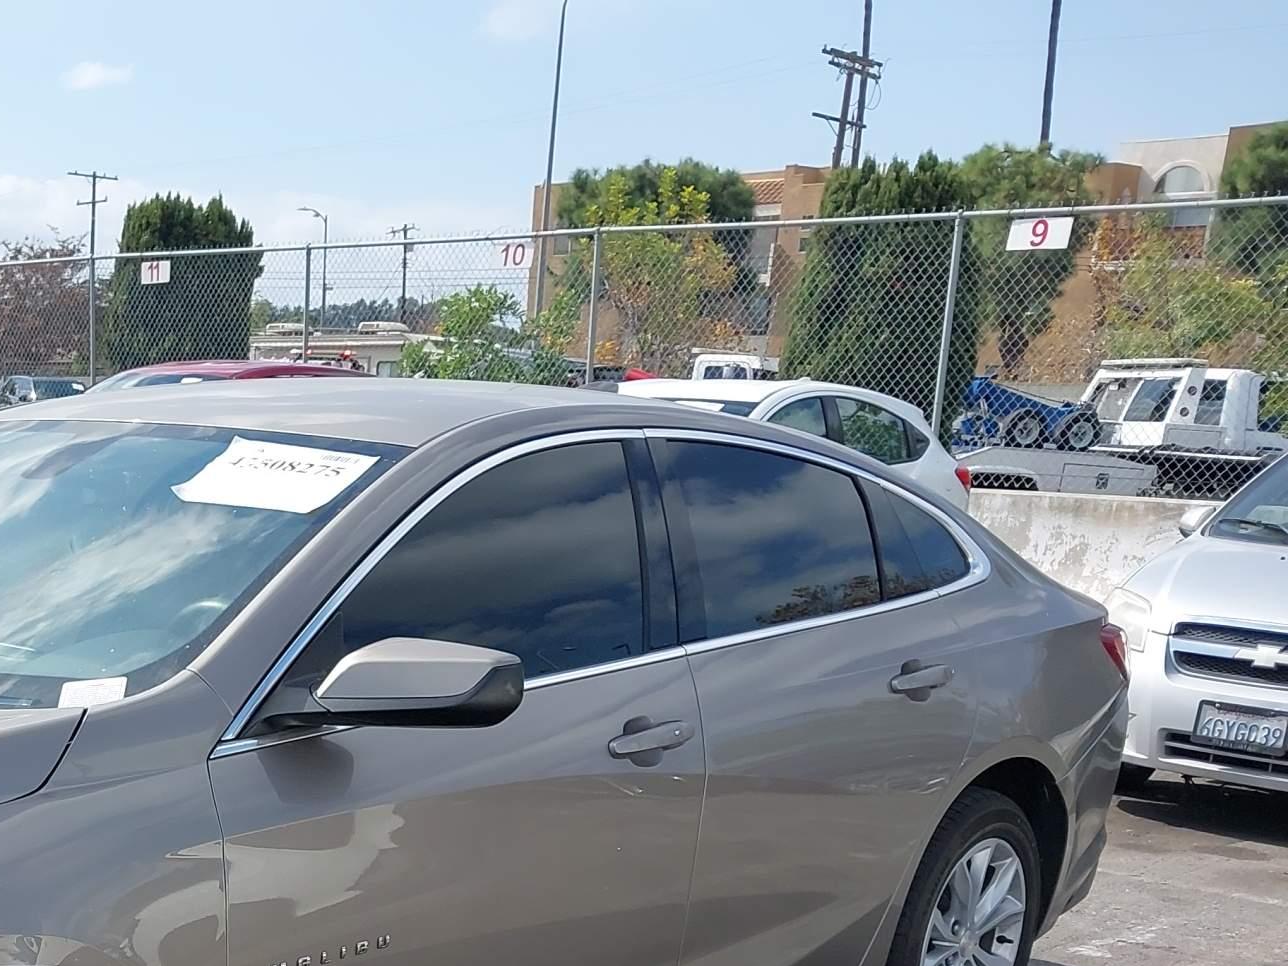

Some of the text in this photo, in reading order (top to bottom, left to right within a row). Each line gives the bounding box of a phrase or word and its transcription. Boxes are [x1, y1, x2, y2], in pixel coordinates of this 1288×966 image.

[1030, 218, 1049, 247] 9
[501, 243, 525, 267] 10
[147, 262, 160, 282] 11
[1199, 716, 1283, 747] 6GYG039
